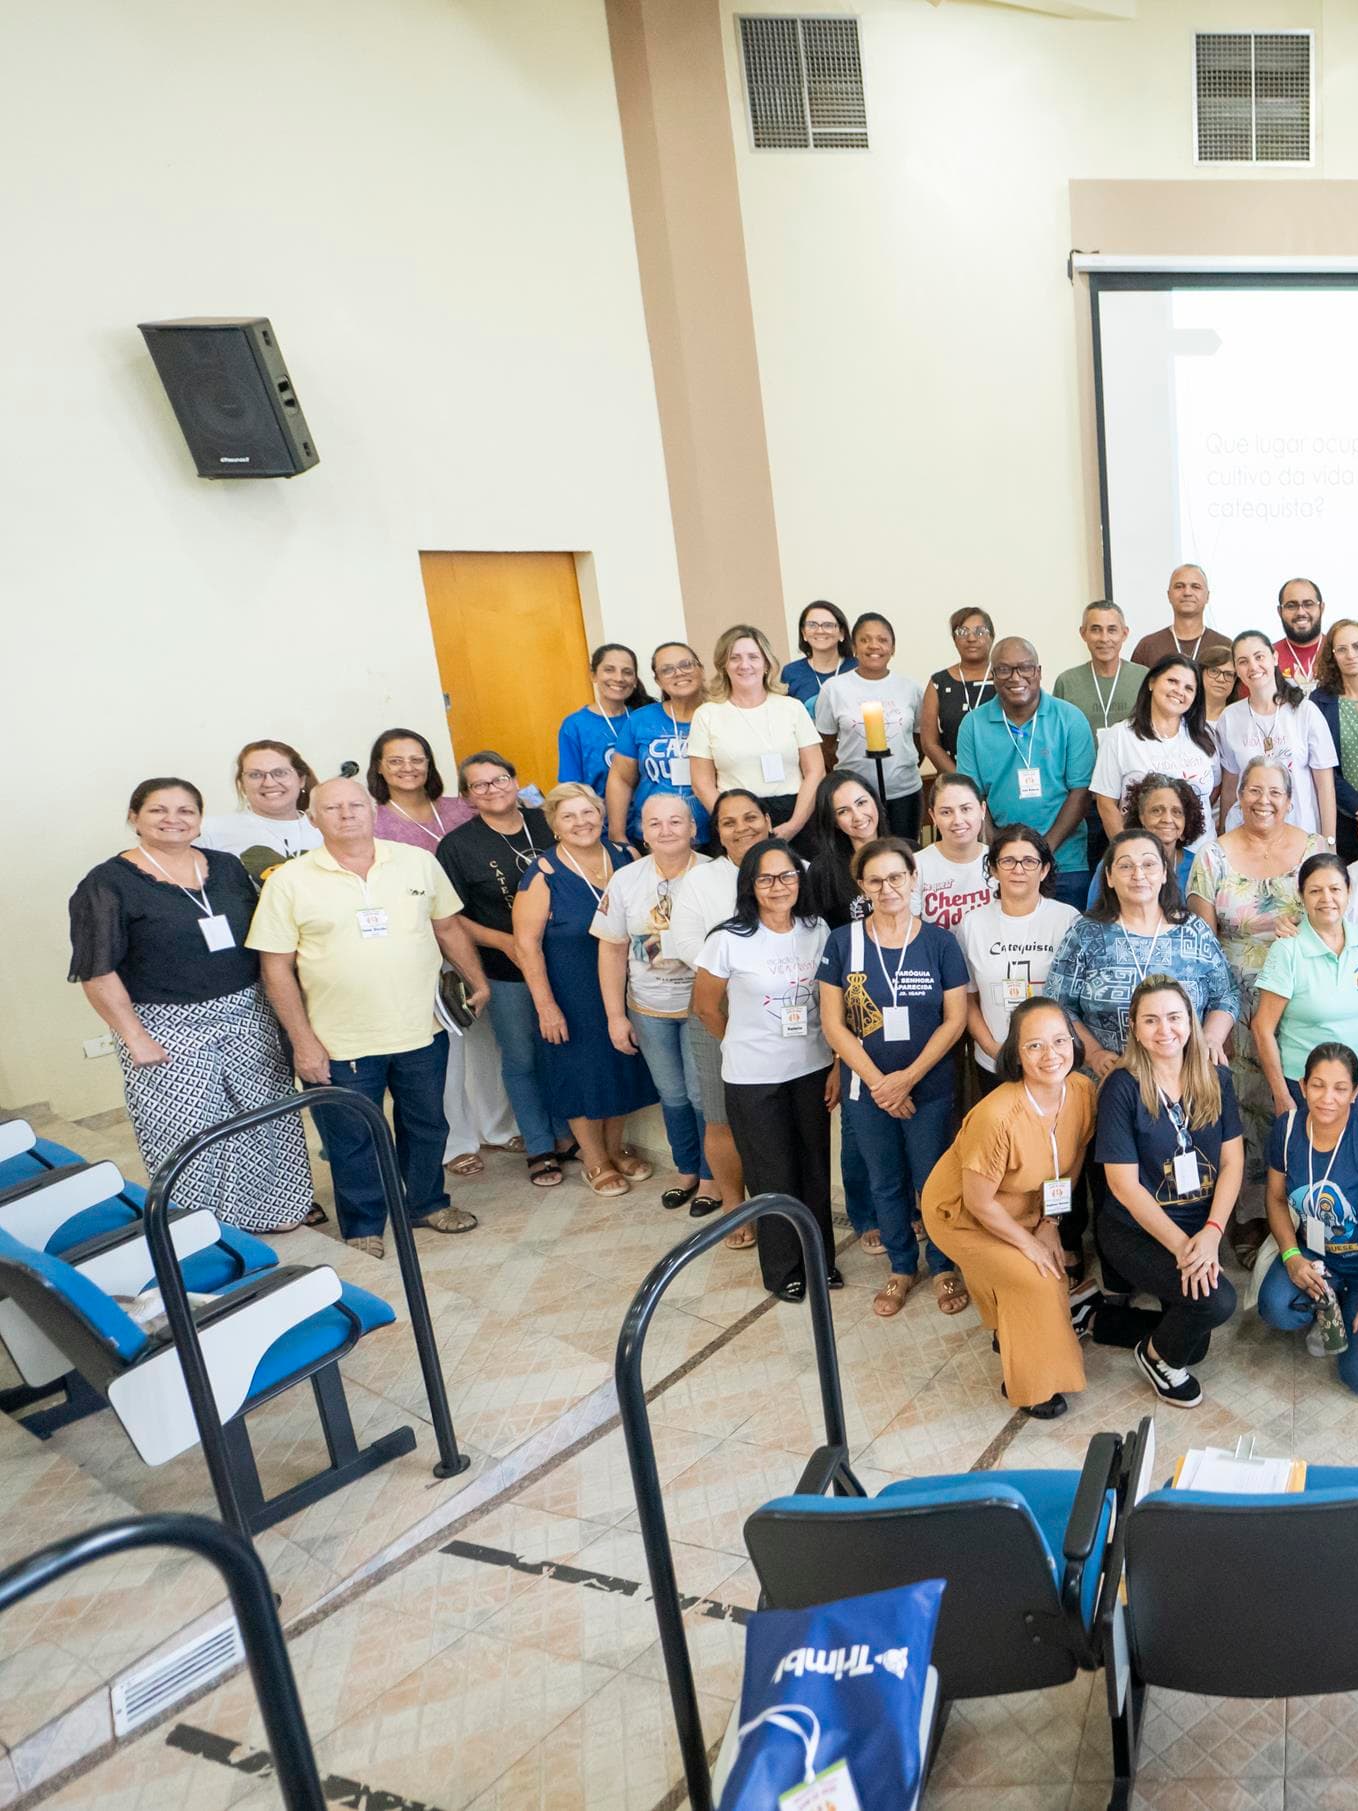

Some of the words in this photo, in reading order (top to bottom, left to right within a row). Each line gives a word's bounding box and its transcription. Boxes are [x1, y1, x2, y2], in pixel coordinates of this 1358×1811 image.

[1206, 432, 1248, 454] Que
[1256, 432, 1304, 460] lugar
[1206, 463, 1272, 487] cultivo
[1312, 463, 1355, 486] vida
[1206, 496, 1327, 527] catequista?
[645, 757, 671, 784] QU
[925, 888, 991, 916] Cherry
[990, 941, 1054, 955] Catequista
[771, 1644, 875, 1684] Trimbl
